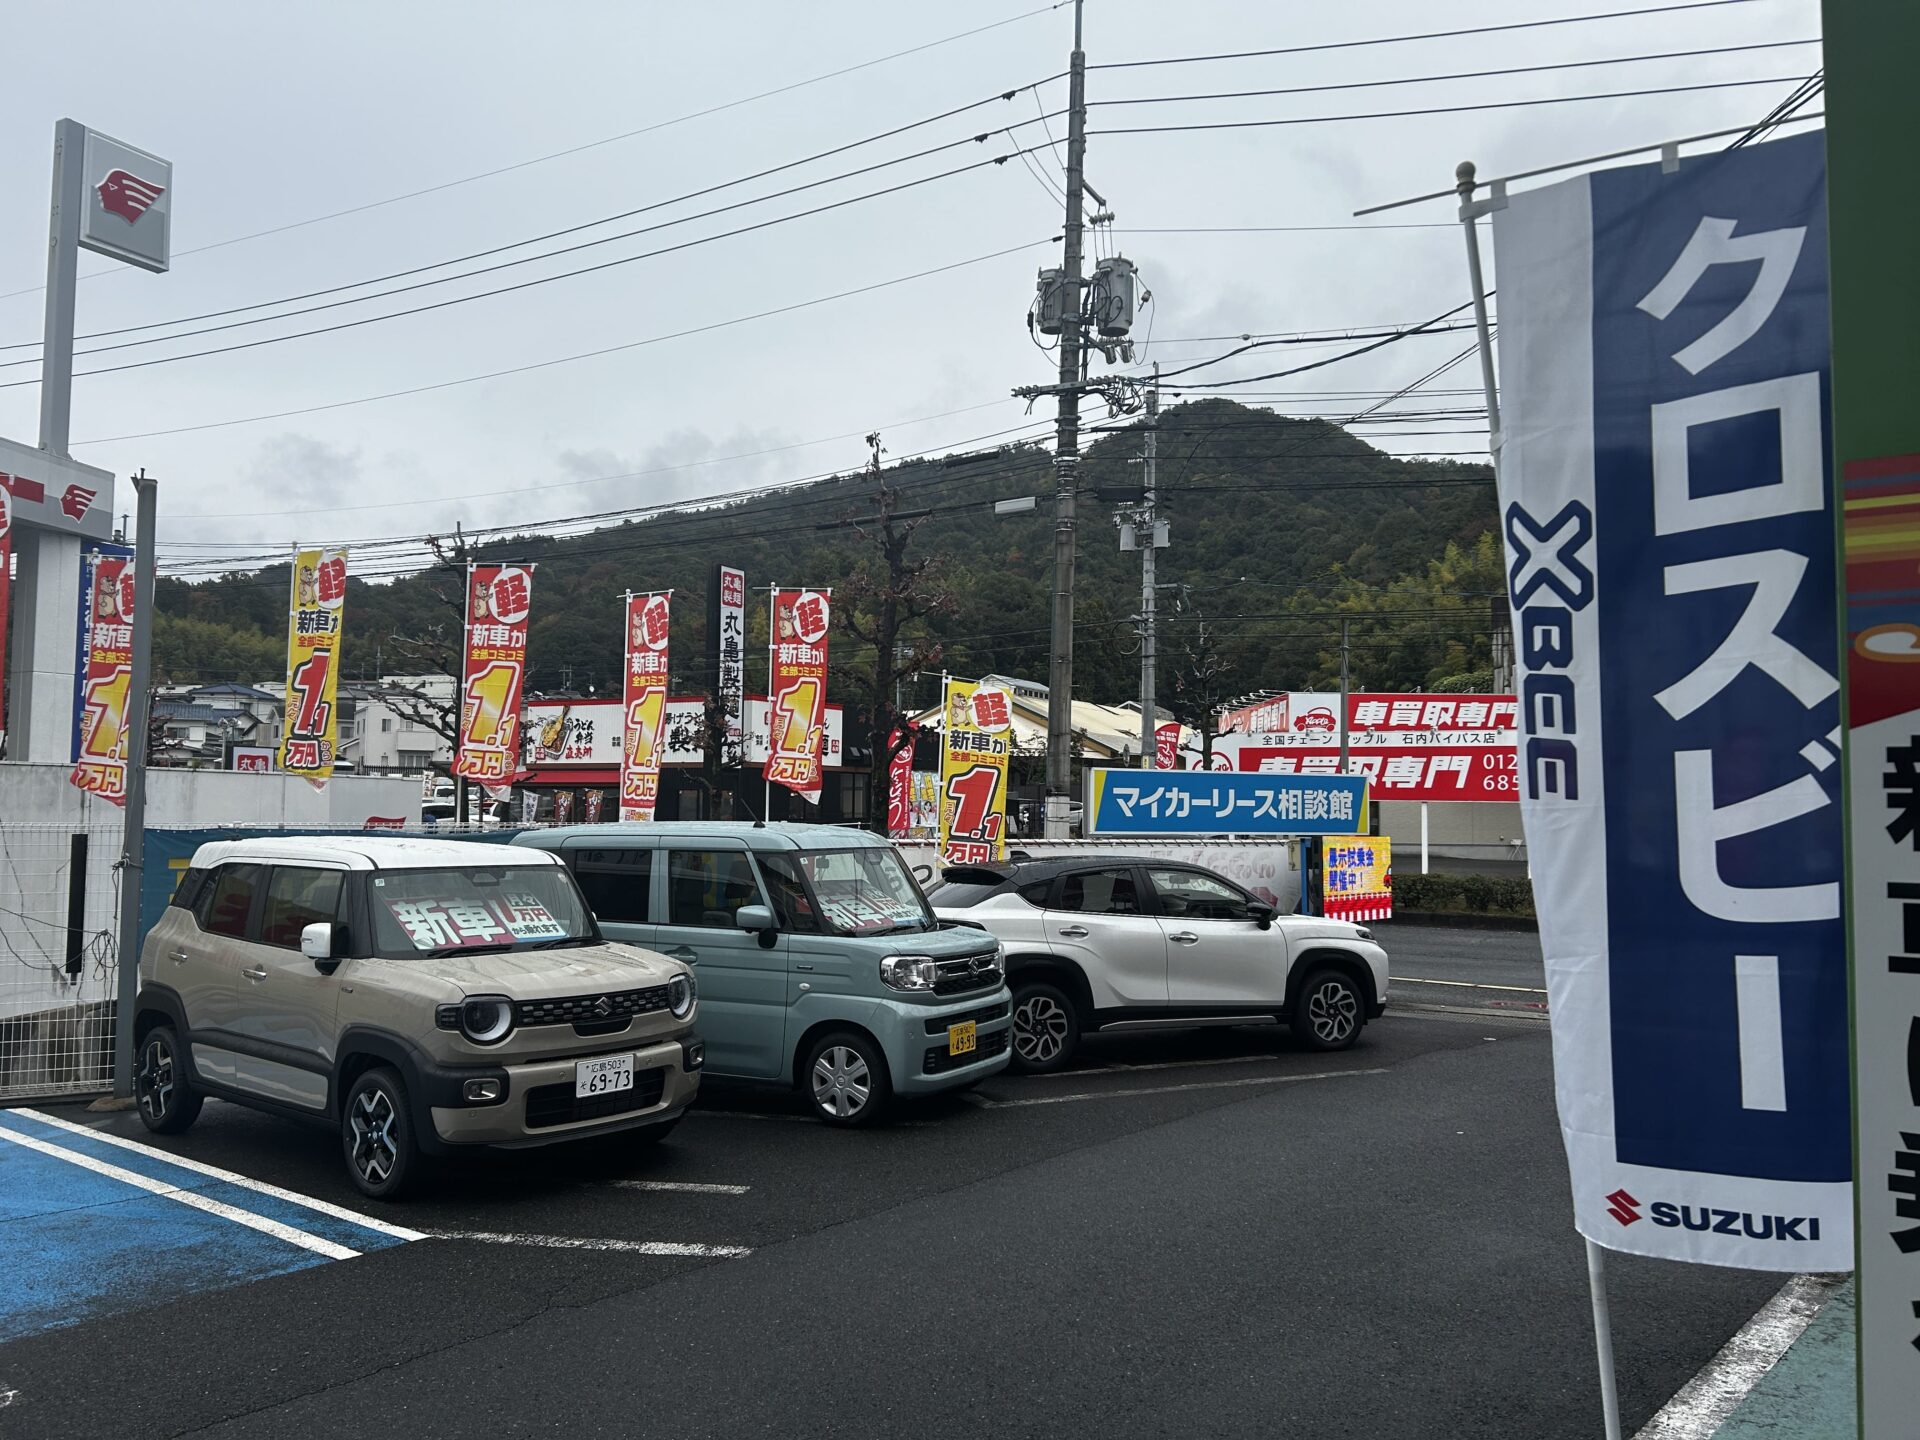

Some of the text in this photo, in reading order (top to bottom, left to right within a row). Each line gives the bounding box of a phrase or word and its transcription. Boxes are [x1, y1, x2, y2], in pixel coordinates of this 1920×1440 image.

[494, 572, 529, 618] 軽
[645, 600, 668, 645] 軽
[796, 597, 826, 637] 軽
[471, 624, 527, 647] 新車が
[778, 643, 824, 665] 新車が
[1505, 499, 1595, 801] XBEE
[1635, 215, 1841, 1112] クロスビー
[779, 665, 823, 677] 全部コミコミ
[466, 662, 518, 747] 1.1
[778, 679, 822, 755] 1.1
[972, 692, 1010, 727] 軽
[574, 718, 595, 731] うどん
[574, 731, 593, 744] 弁当
[565, 745, 592, 759] 直売所
[949, 729, 1007, 753] 新車が
[1262, 733, 1496, 746] 全国チェーン ップル 石内バイパス店
[460, 748, 503, 776] 万円
[770, 756, 811, 781] 万円
[950, 751, 1005, 766] 全部コミコミ
[78, 765, 124, 793] 万円
[625, 773, 659, 799] 万円
[948, 766, 1001, 840] 1.1
[1112, 786, 1353, 821] マイカーリース相談館
[946, 842, 989, 864] 万円
[392, 899, 506, 949] 新車
[512, 907, 554, 922] 万円
[589, 1070, 631, 1092] 69-73
[1650, 1201, 1820, 1242] SUZUKI
